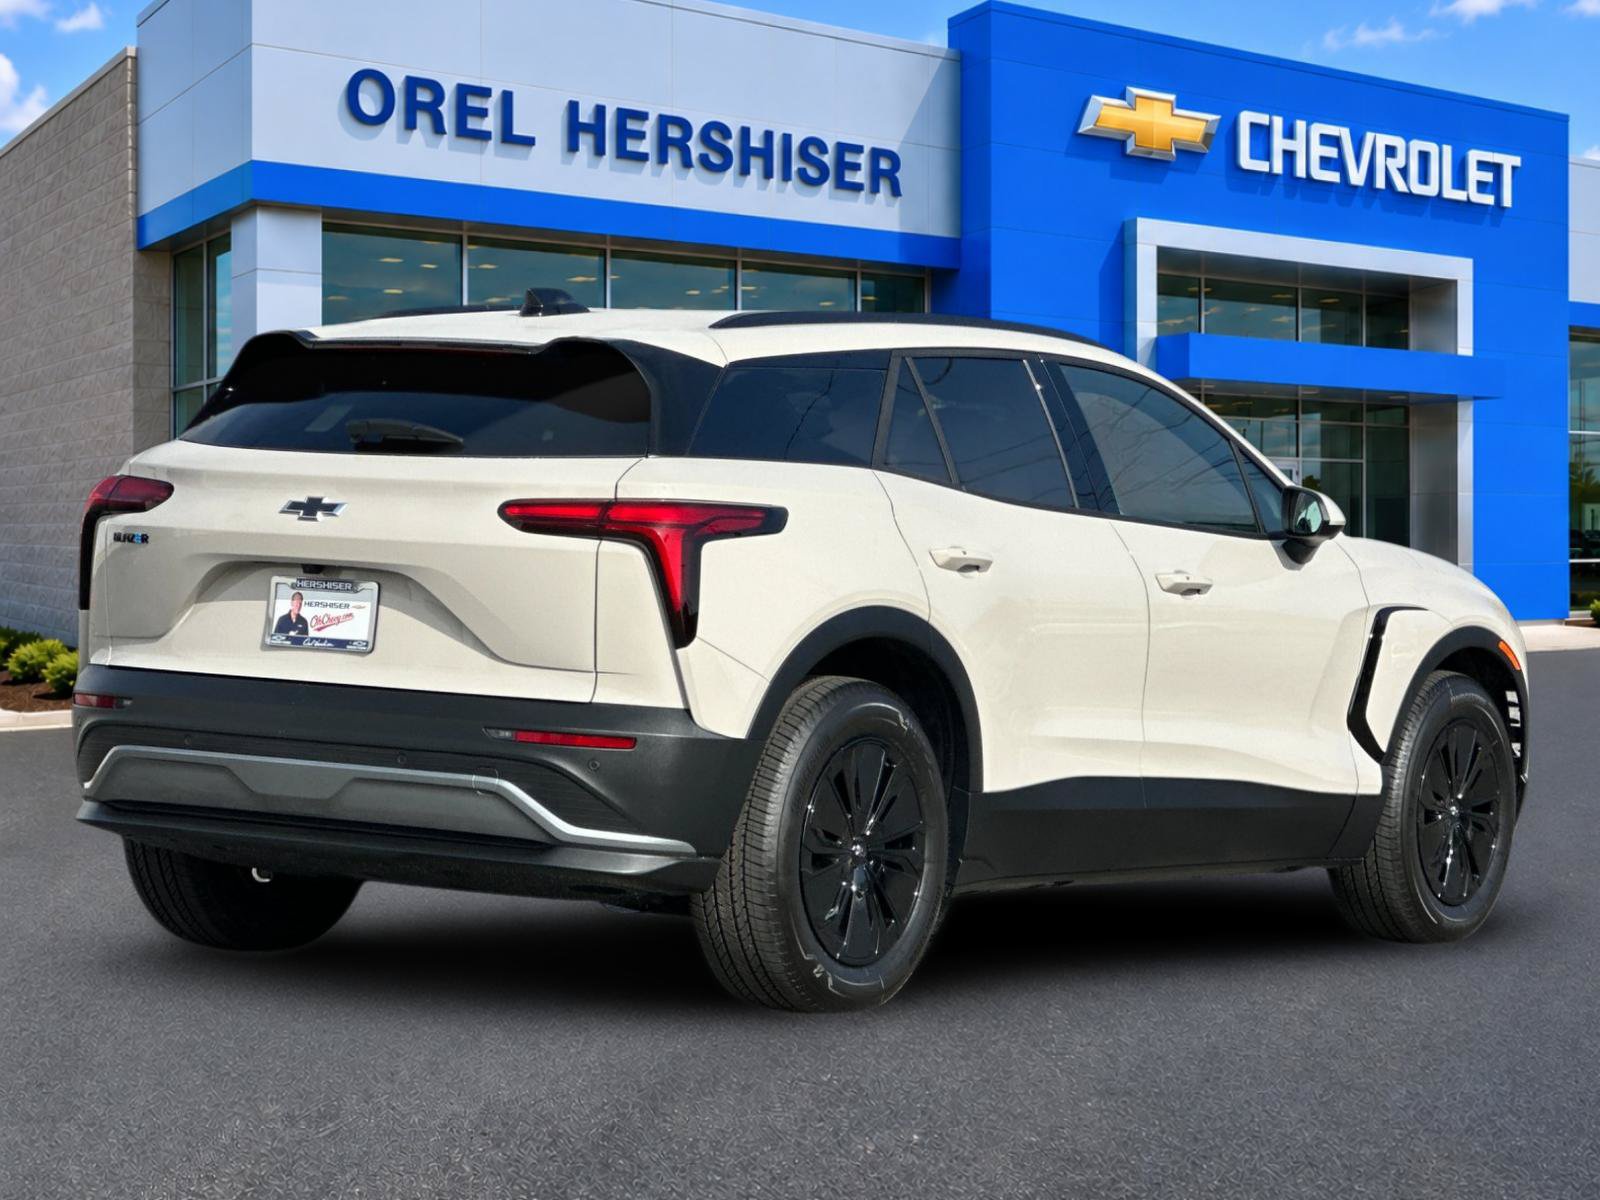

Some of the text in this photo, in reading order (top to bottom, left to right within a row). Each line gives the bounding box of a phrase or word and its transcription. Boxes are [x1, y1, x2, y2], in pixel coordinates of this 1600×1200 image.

[346, 68, 903, 198] OREL HERSHISER
[1236, 109, 1522, 208] CHEVROLET
[296, 580, 353, 590] HERSHISER
[303, 601, 350, 609] HERSHISER
